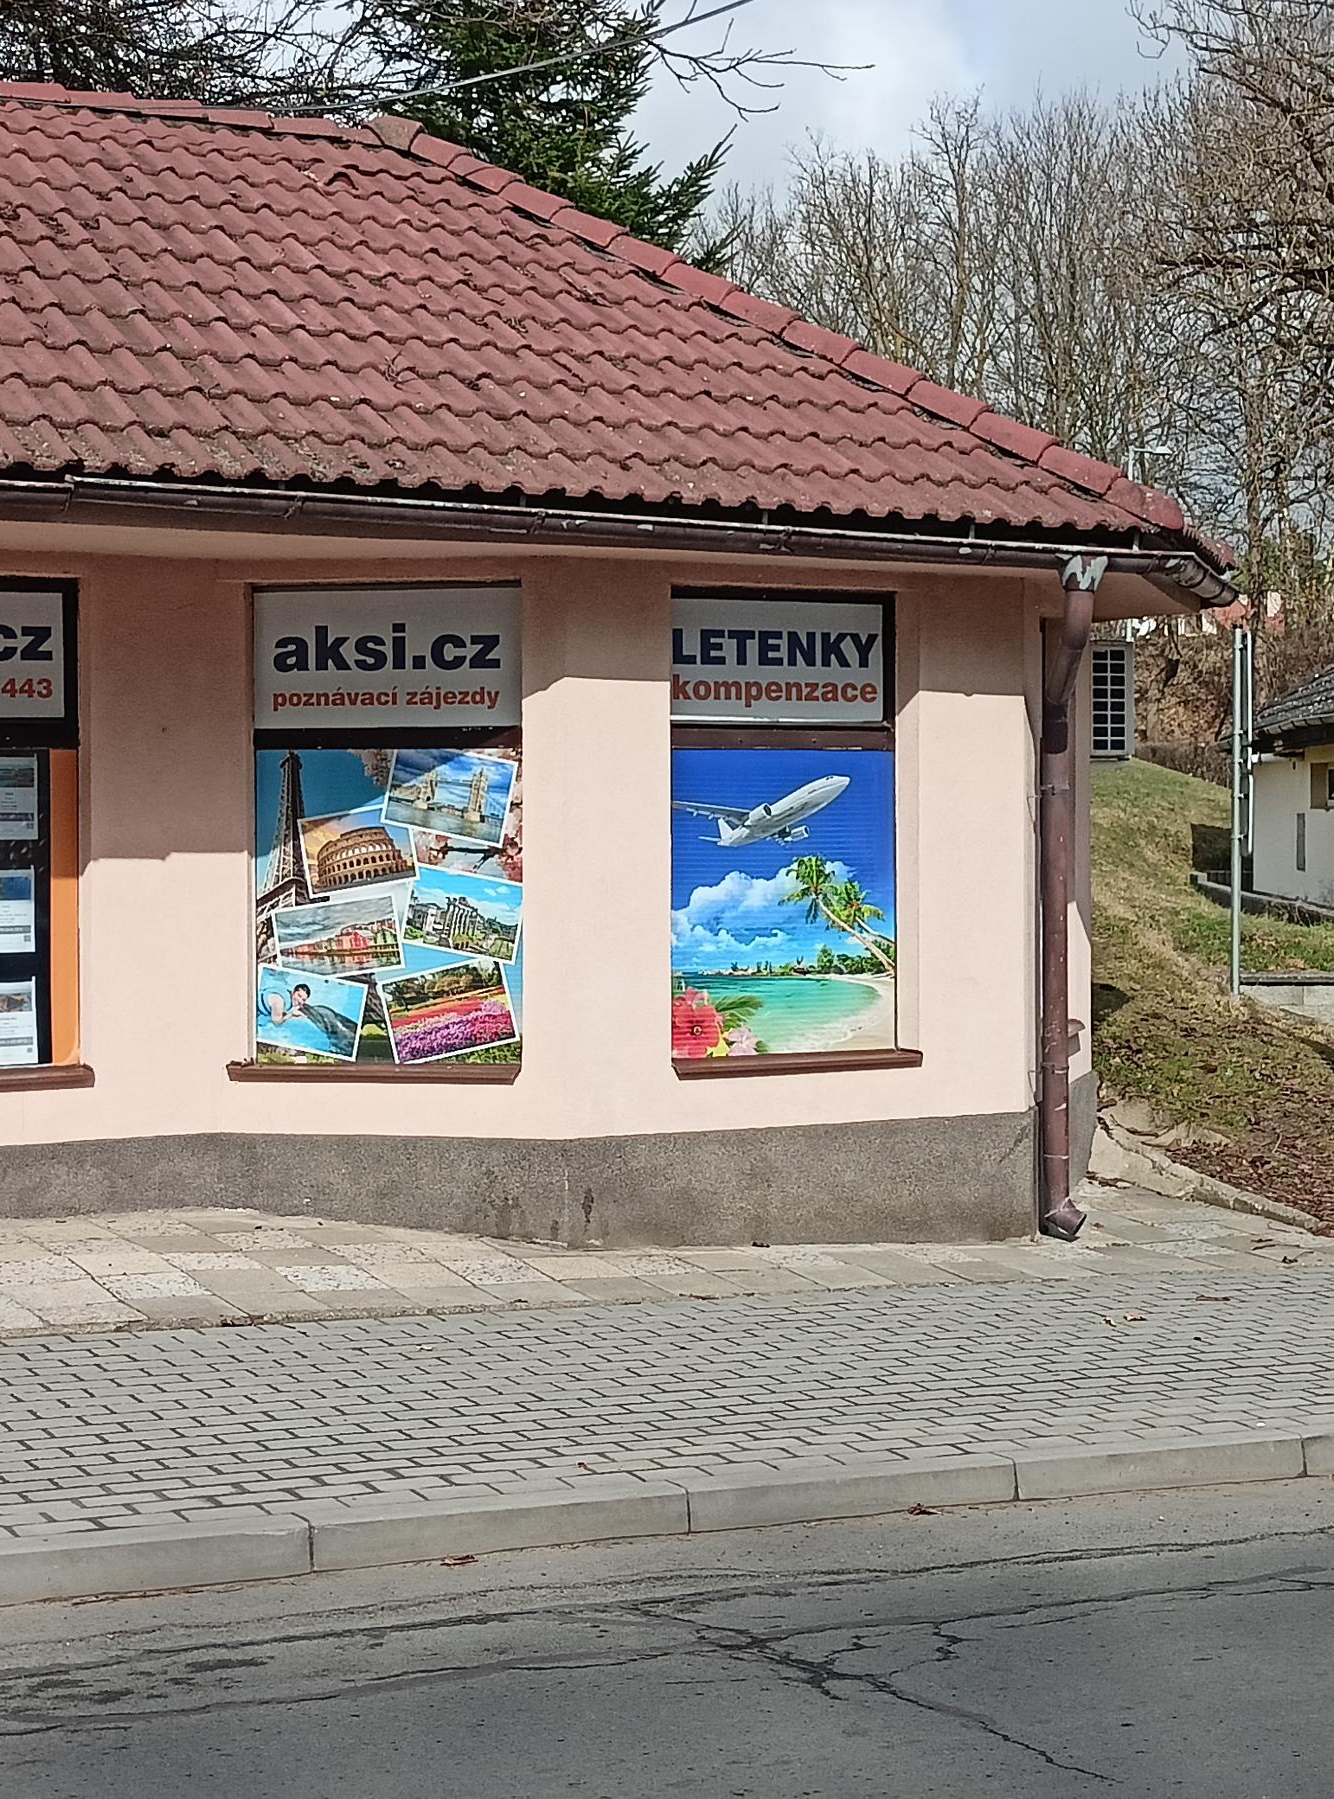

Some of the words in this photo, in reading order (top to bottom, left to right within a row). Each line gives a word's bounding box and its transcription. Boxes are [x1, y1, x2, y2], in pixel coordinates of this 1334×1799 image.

[272, 622, 501, 673] aksi.cz
[672, 627, 879, 668] LETENKY
[0, 677, 54, 699] 443
[272, 686, 399, 712] poznávací
[405, 686, 501, 710] zájezdy
[672, 674, 878, 708] kompenzace
